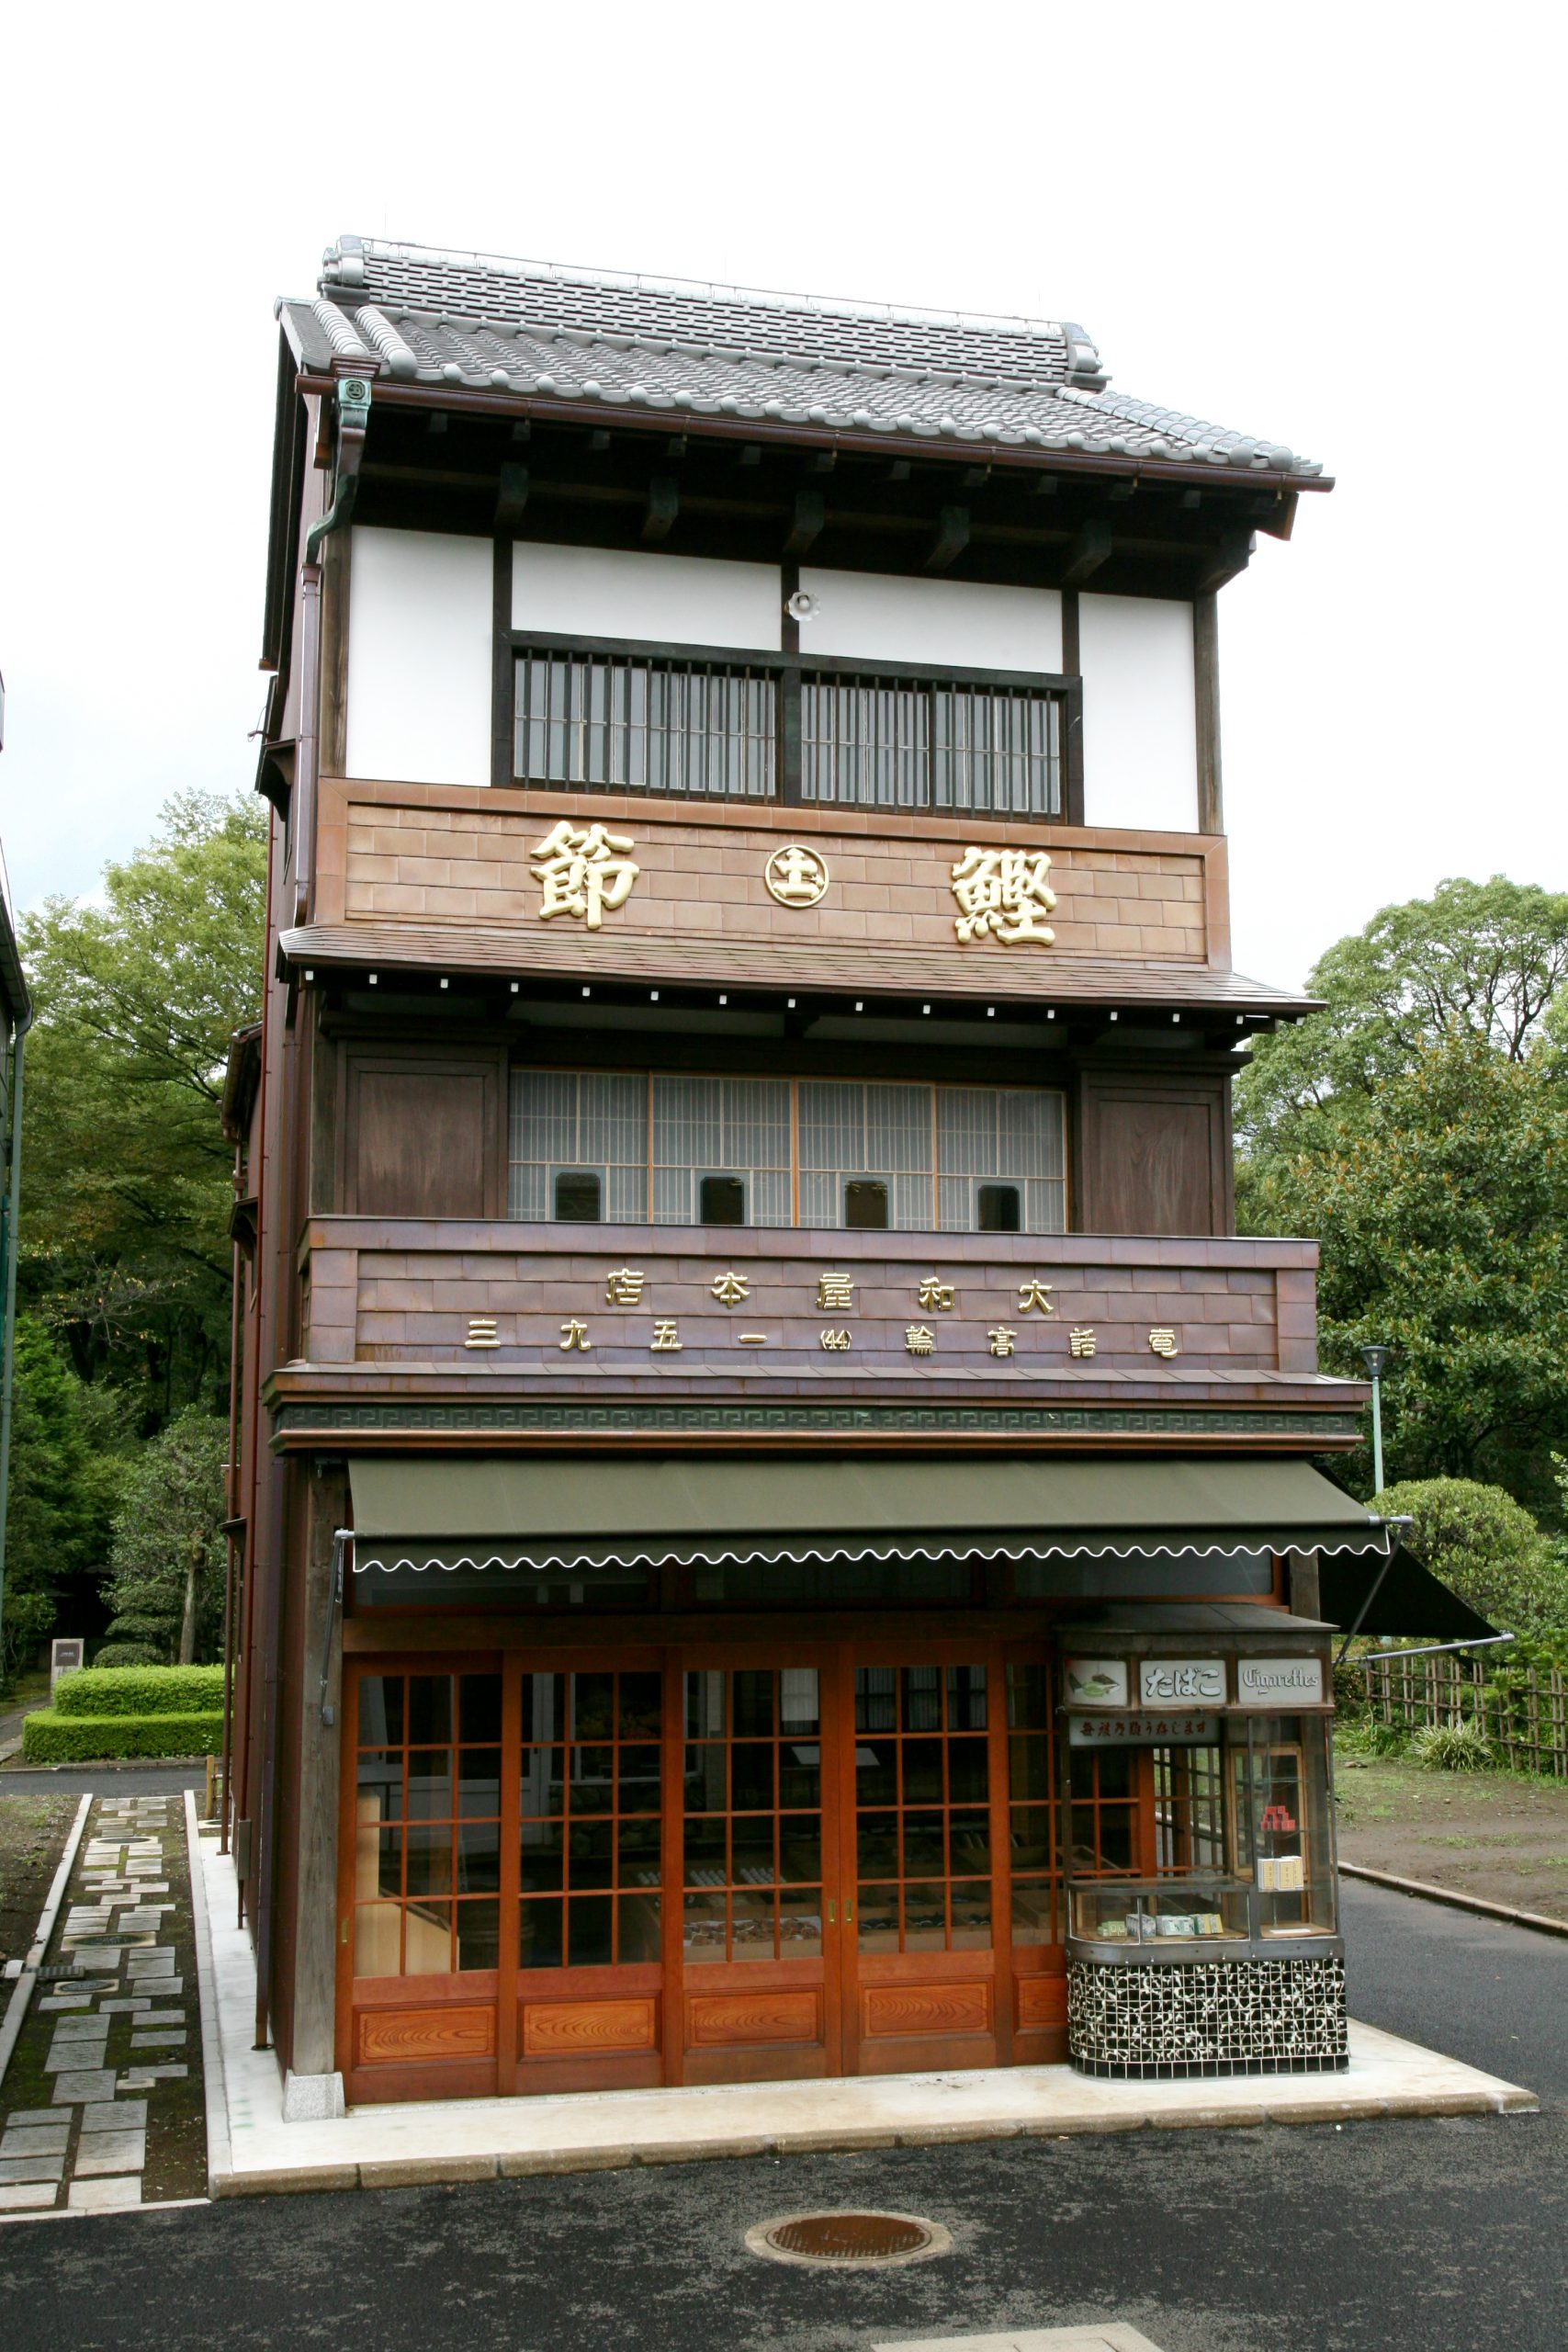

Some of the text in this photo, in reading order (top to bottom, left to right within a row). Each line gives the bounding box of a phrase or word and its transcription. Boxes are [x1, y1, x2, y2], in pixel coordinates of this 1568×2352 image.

[530, 820, 640, 930] 節
[605, 1268, 1054, 1315] 大和屋本店
[1146, 1667, 1222, 1698] たばこ
[1243, 1666, 1319, 1695] Cigarettes
